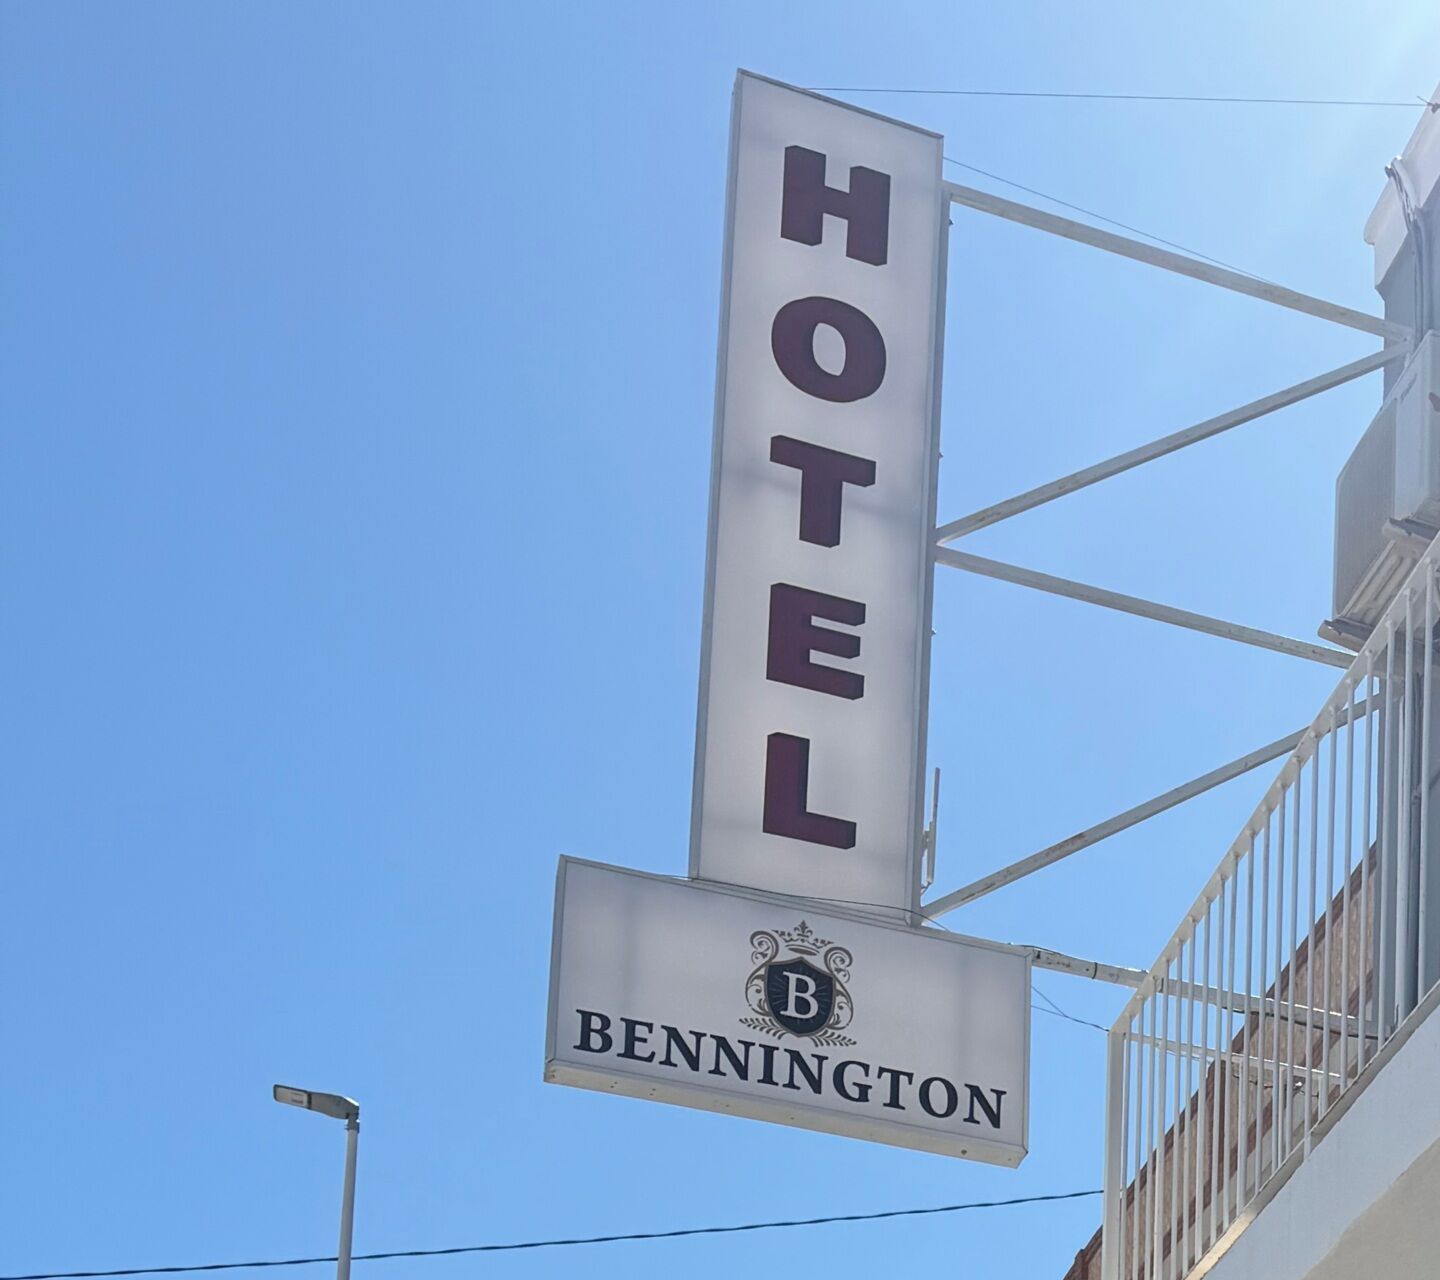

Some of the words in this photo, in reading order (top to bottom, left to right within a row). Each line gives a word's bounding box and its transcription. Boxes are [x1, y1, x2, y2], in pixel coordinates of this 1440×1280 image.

[763, 144, 892, 851] HOTEL
[779, 971, 820, 1021] B
[573, 1008, 1007, 1130] BENNINGTON
